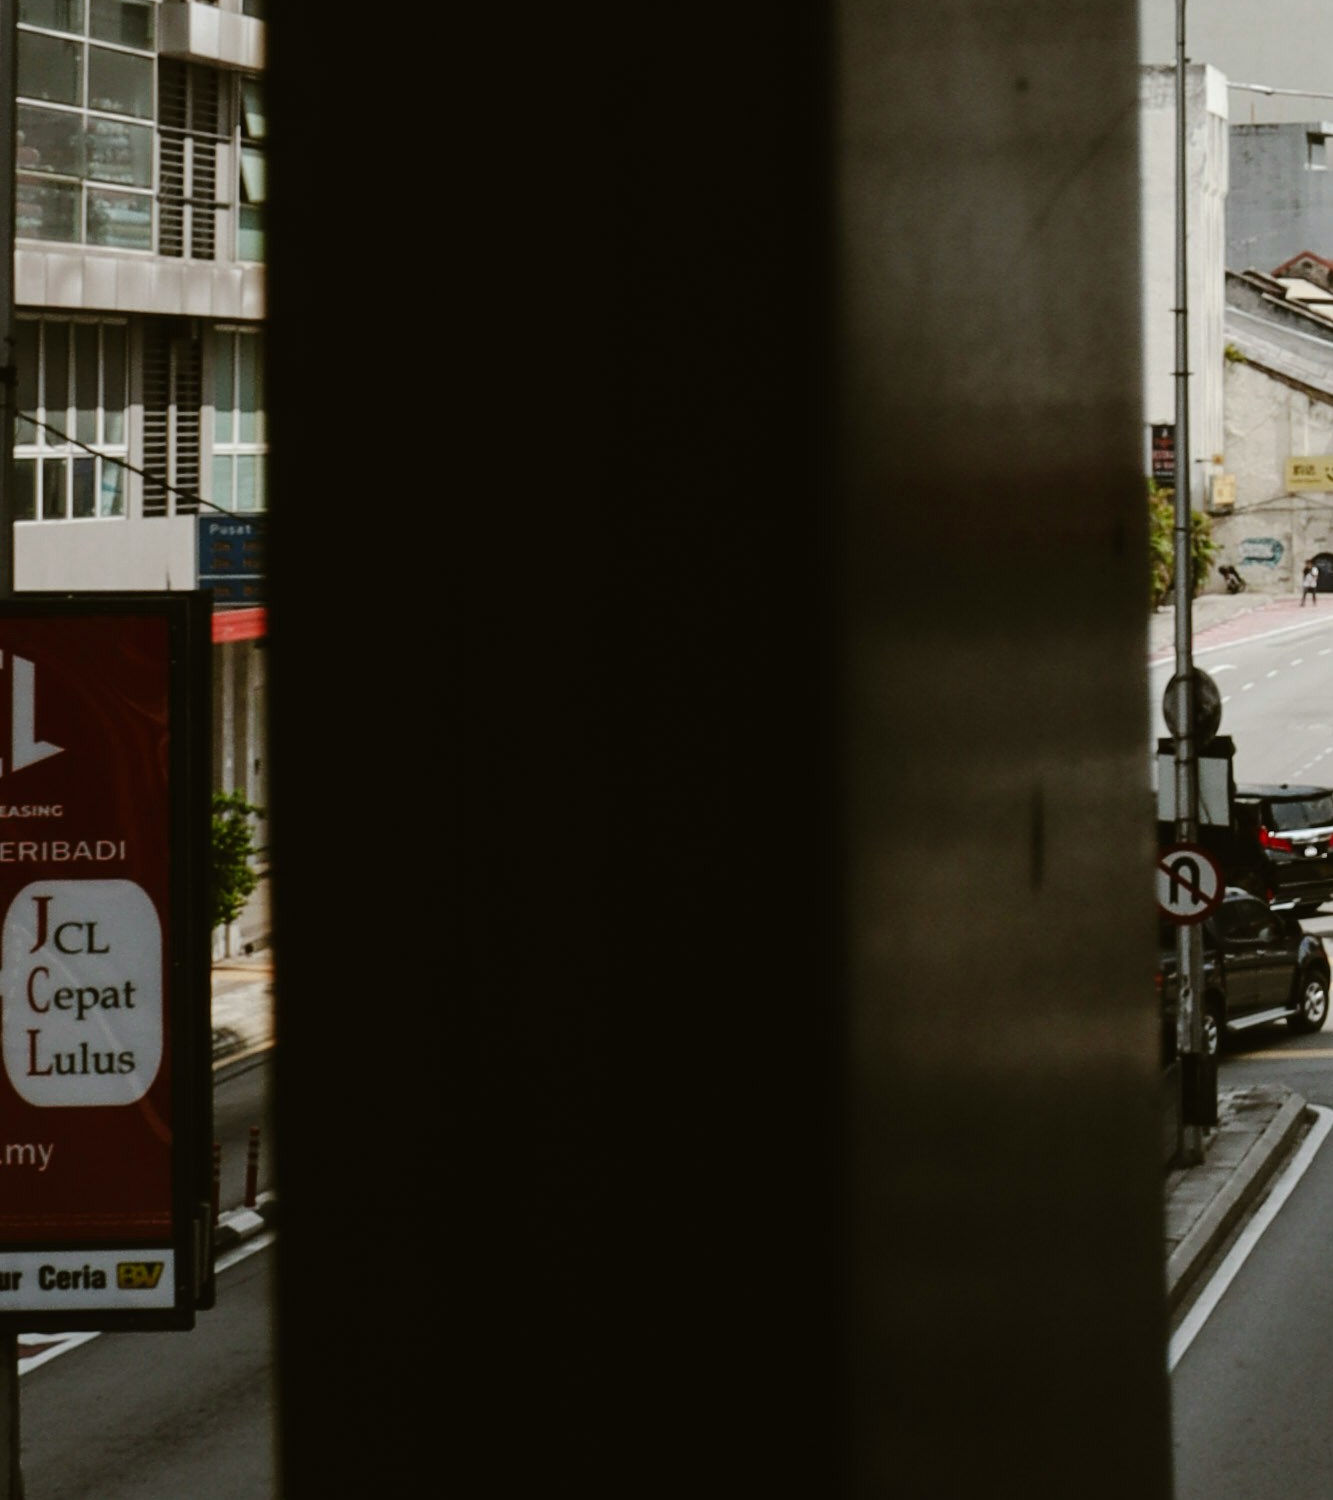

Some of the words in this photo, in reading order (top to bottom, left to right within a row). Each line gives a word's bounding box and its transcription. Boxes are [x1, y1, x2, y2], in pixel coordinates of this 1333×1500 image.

[208, 523, 252, 535] Pusat
[0, 839, 126, 862] ERIBADI
[30, 896, 110, 955] JCL
[27, 966, 136, 1021] Cepat
[26, 1028, 136, 1077] Lulus
[38, 1265, 107, 1291] Ceria
